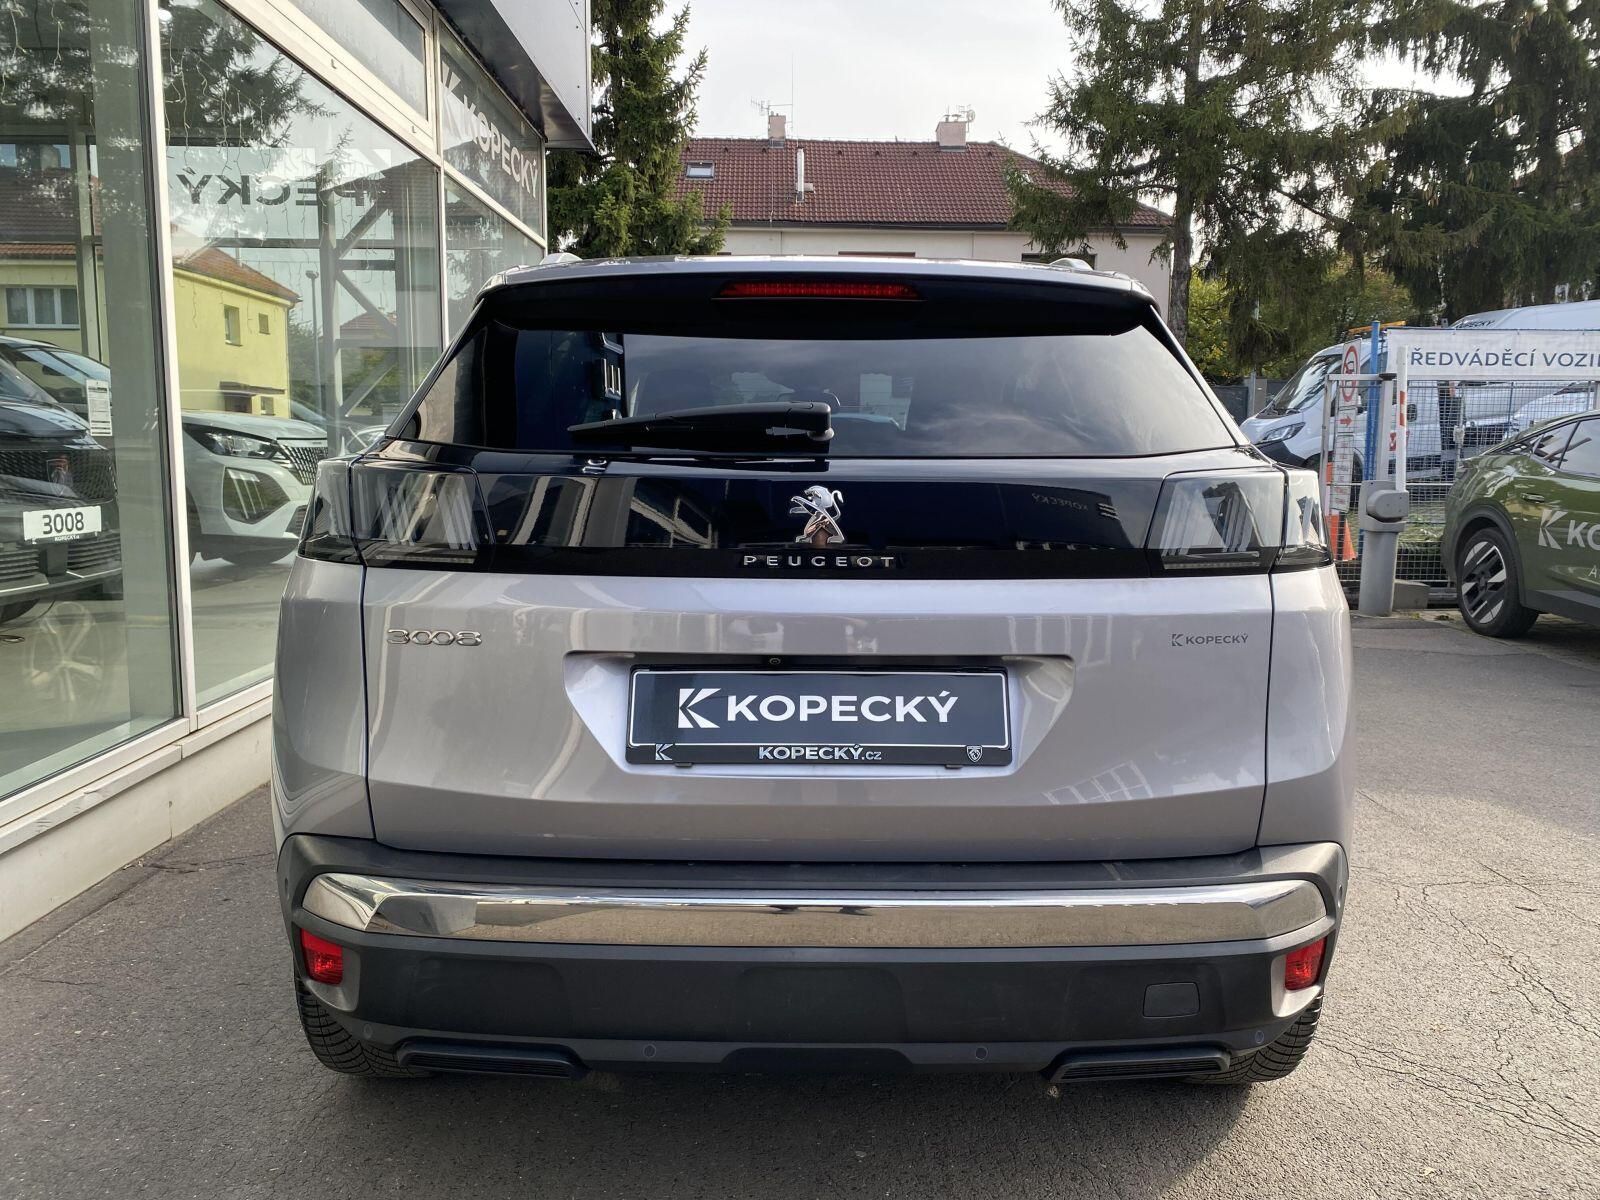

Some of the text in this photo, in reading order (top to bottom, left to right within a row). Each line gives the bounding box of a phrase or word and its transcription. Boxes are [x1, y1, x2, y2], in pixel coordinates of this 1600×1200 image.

[1410, 347, 1536, 367] ŘEDVÁDĚCÍ
[42, 511, 84, 534] 3008
[743, 555, 895, 568] PEUGEOT
[387, 628, 482, 647] 3008
[1185, 632, 1249, 645] KOPECKÝ
[727, 690, 959, 723] KOPECKÝ
[758, 744, 882, 761] KOPECKÝ.cz
